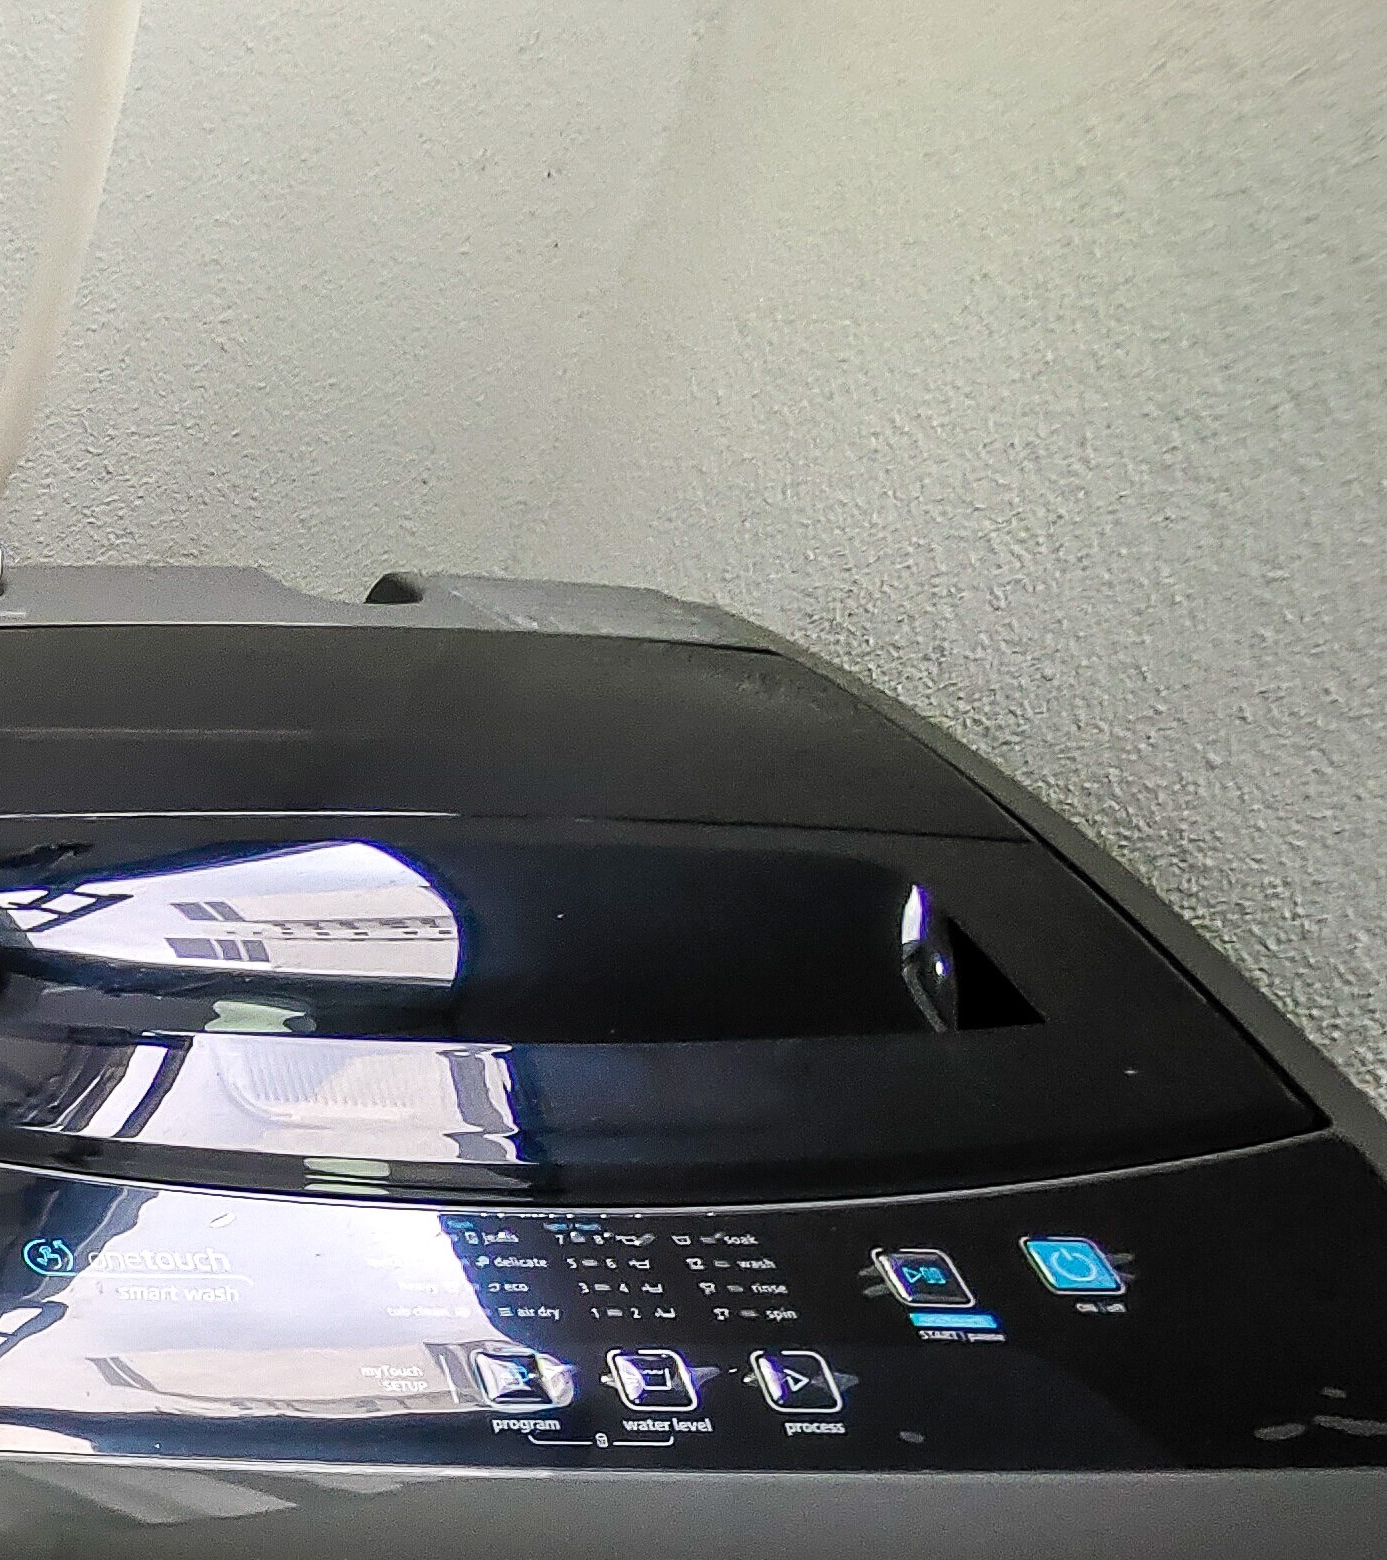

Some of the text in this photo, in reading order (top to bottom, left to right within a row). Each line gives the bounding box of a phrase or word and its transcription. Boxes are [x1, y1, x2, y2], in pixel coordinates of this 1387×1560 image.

[493, 1256, 549, 1268] delicate
[491, 1417, 562, 1434] program
[622, 1417, 714, 1432] water level
[784, 1420, 846, 1436] process
